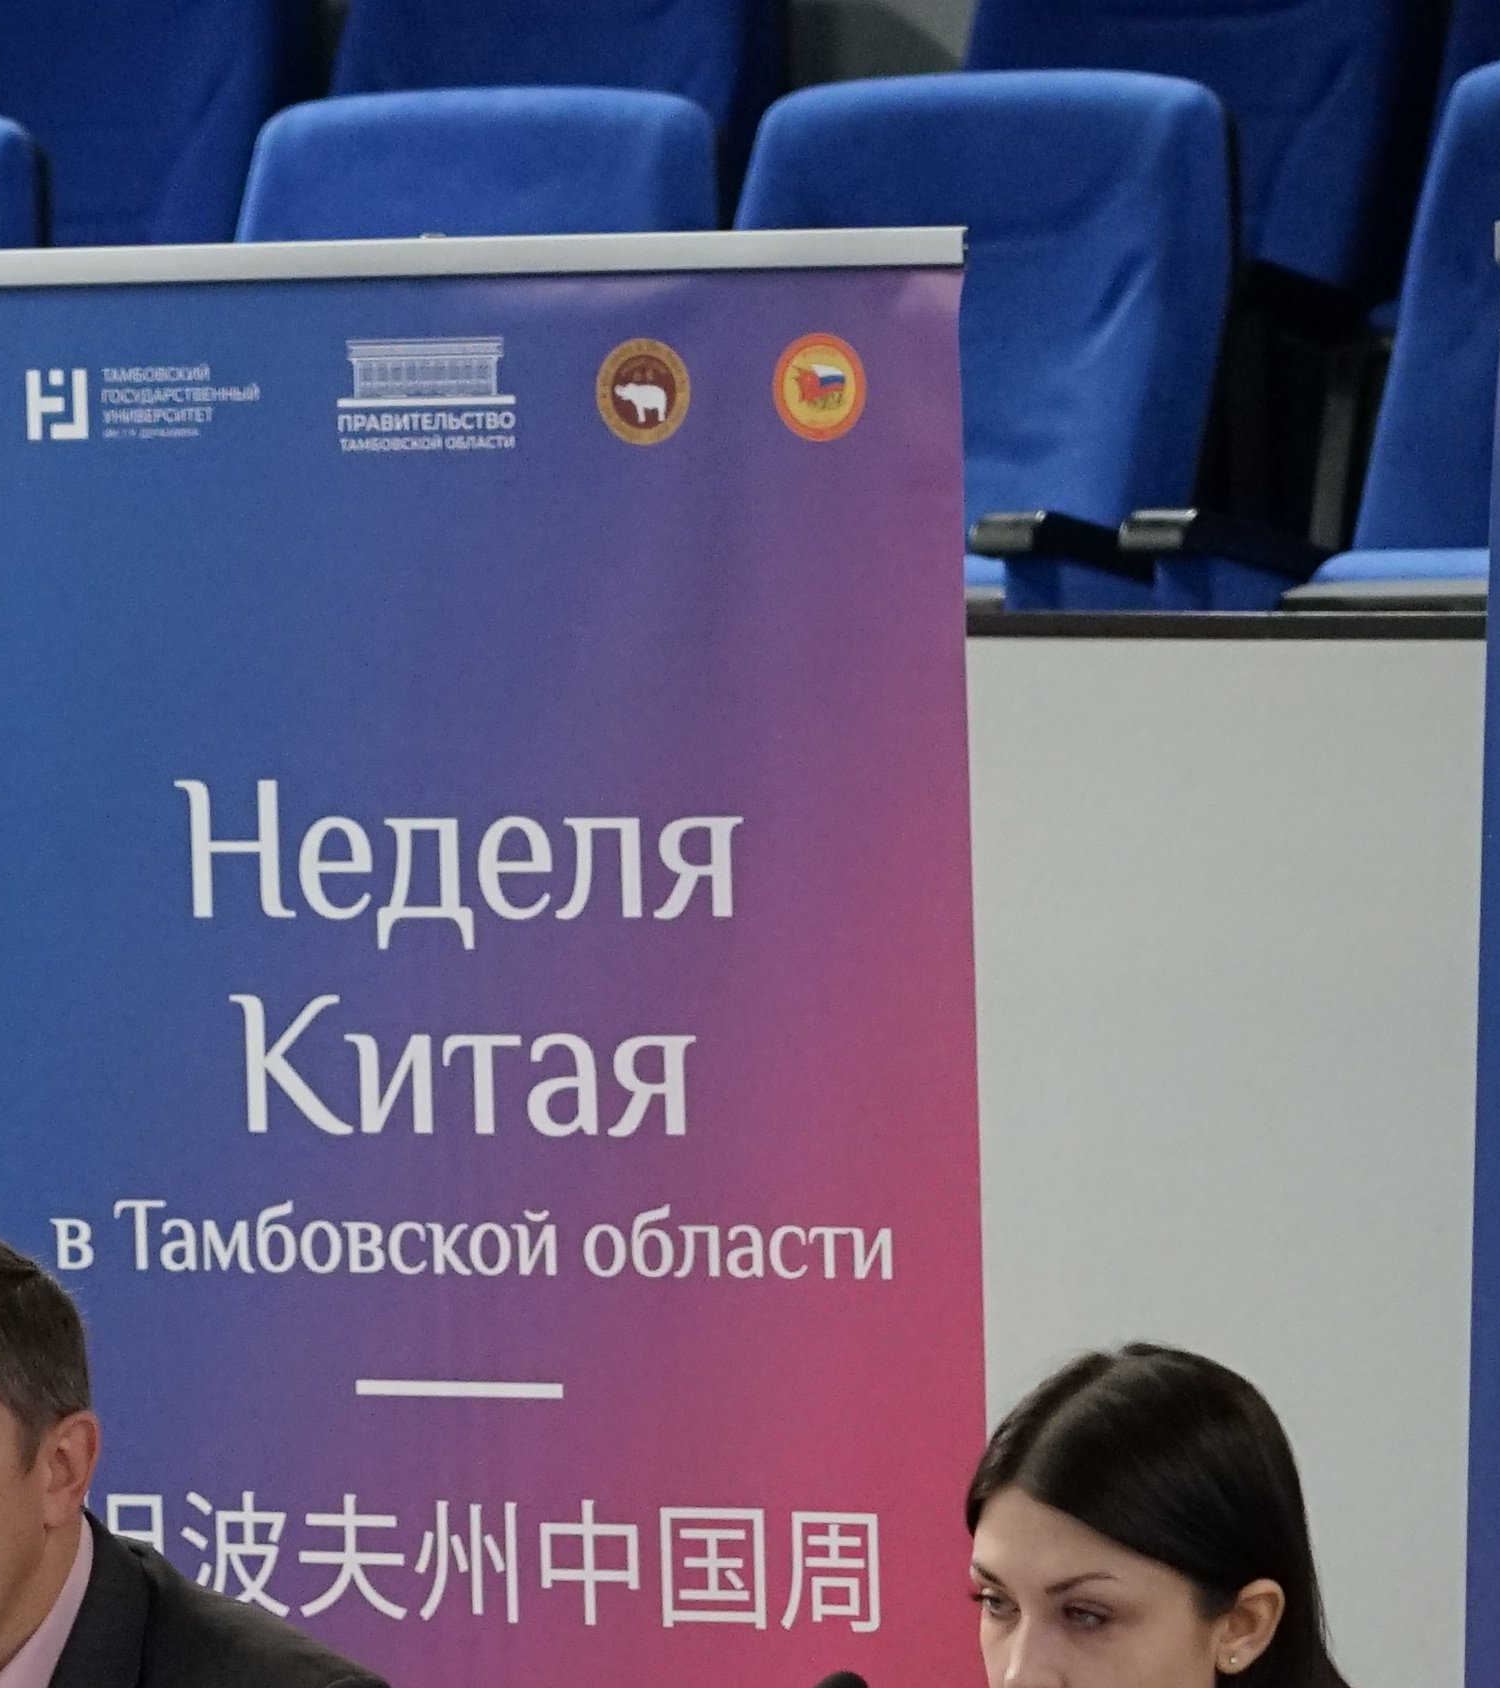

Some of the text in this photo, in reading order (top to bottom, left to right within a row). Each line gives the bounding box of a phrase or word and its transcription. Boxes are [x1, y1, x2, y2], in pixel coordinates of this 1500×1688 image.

[337, 411, 516, 432] ПРАВИТЕЛЬСТВО
[173, 779, 744, 951] Неделя
[229, 994, 697, 1137] Китая
[51, 1199, 894, 1281] в Тамбовской области
